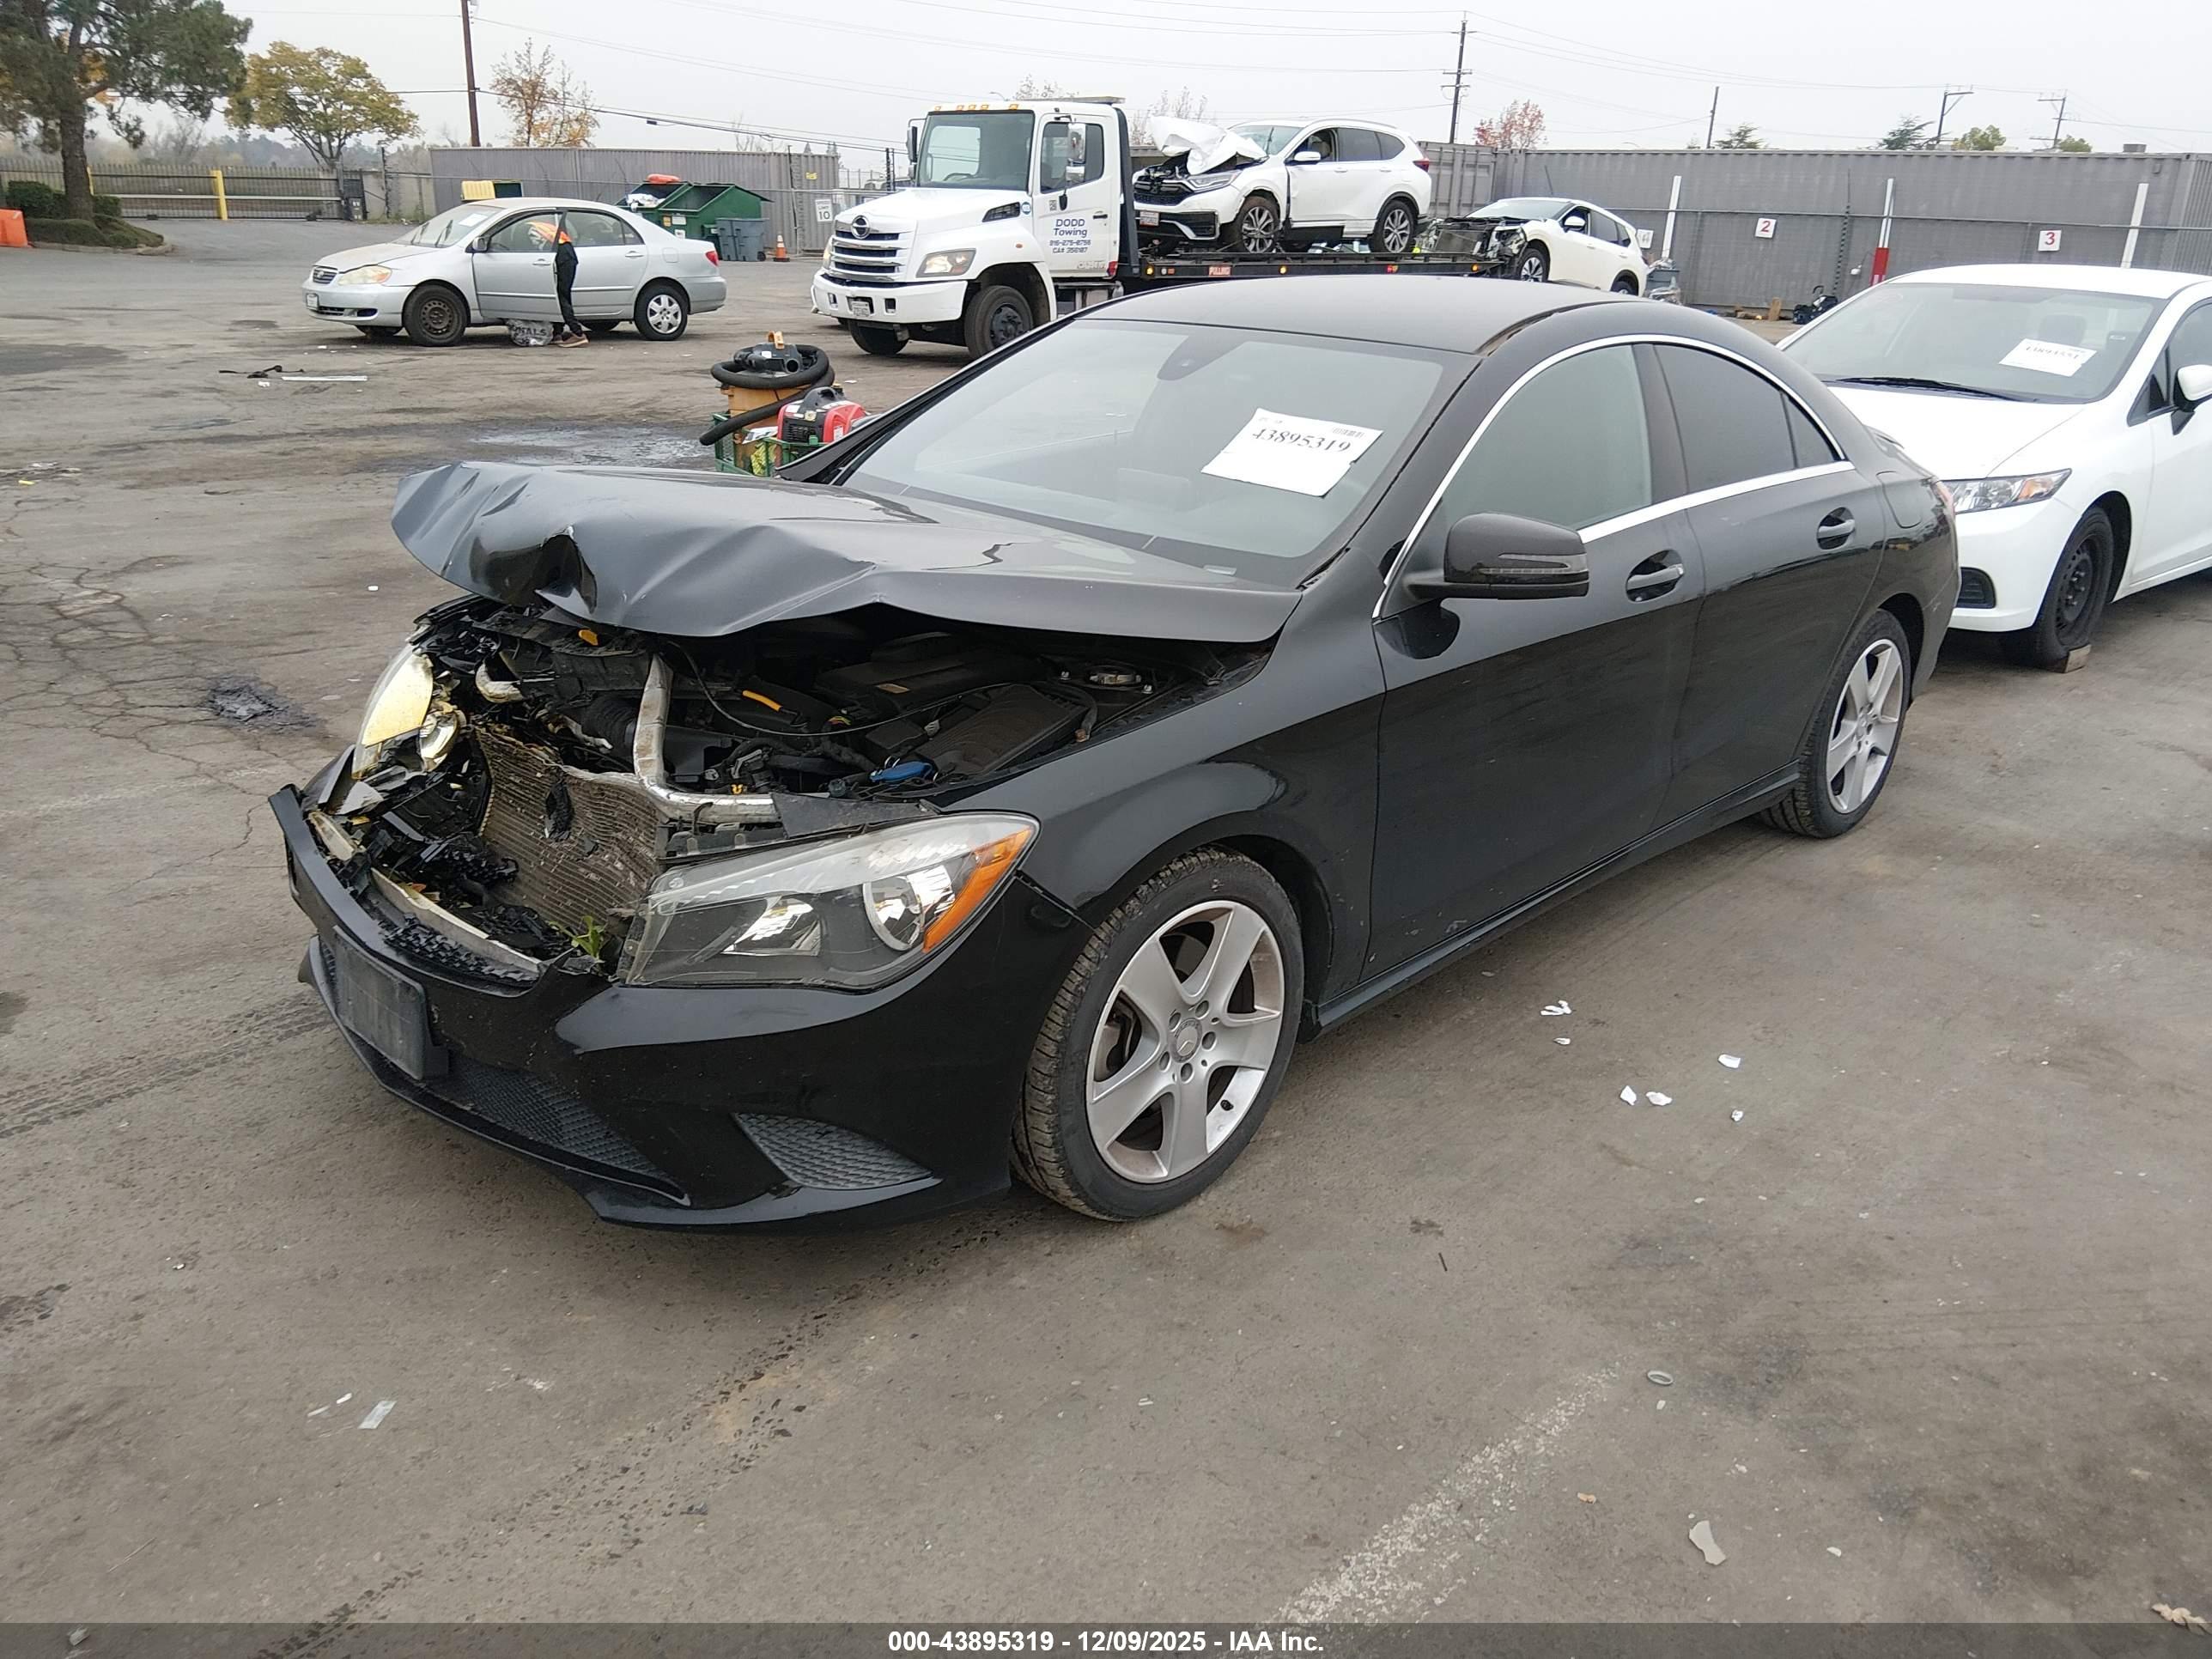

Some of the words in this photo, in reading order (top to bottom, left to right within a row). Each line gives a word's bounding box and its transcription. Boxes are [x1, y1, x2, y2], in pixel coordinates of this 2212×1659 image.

[818, 210, 830, 220] 10
[1055, 218, 1086, 227] DODD
[1760, 220, 1771, 233] 2
[1053, 228, 1088, 238] Towing
[2045, 232, 2056, 246] 3
[1252, 428, 1352, 453] 43895319
